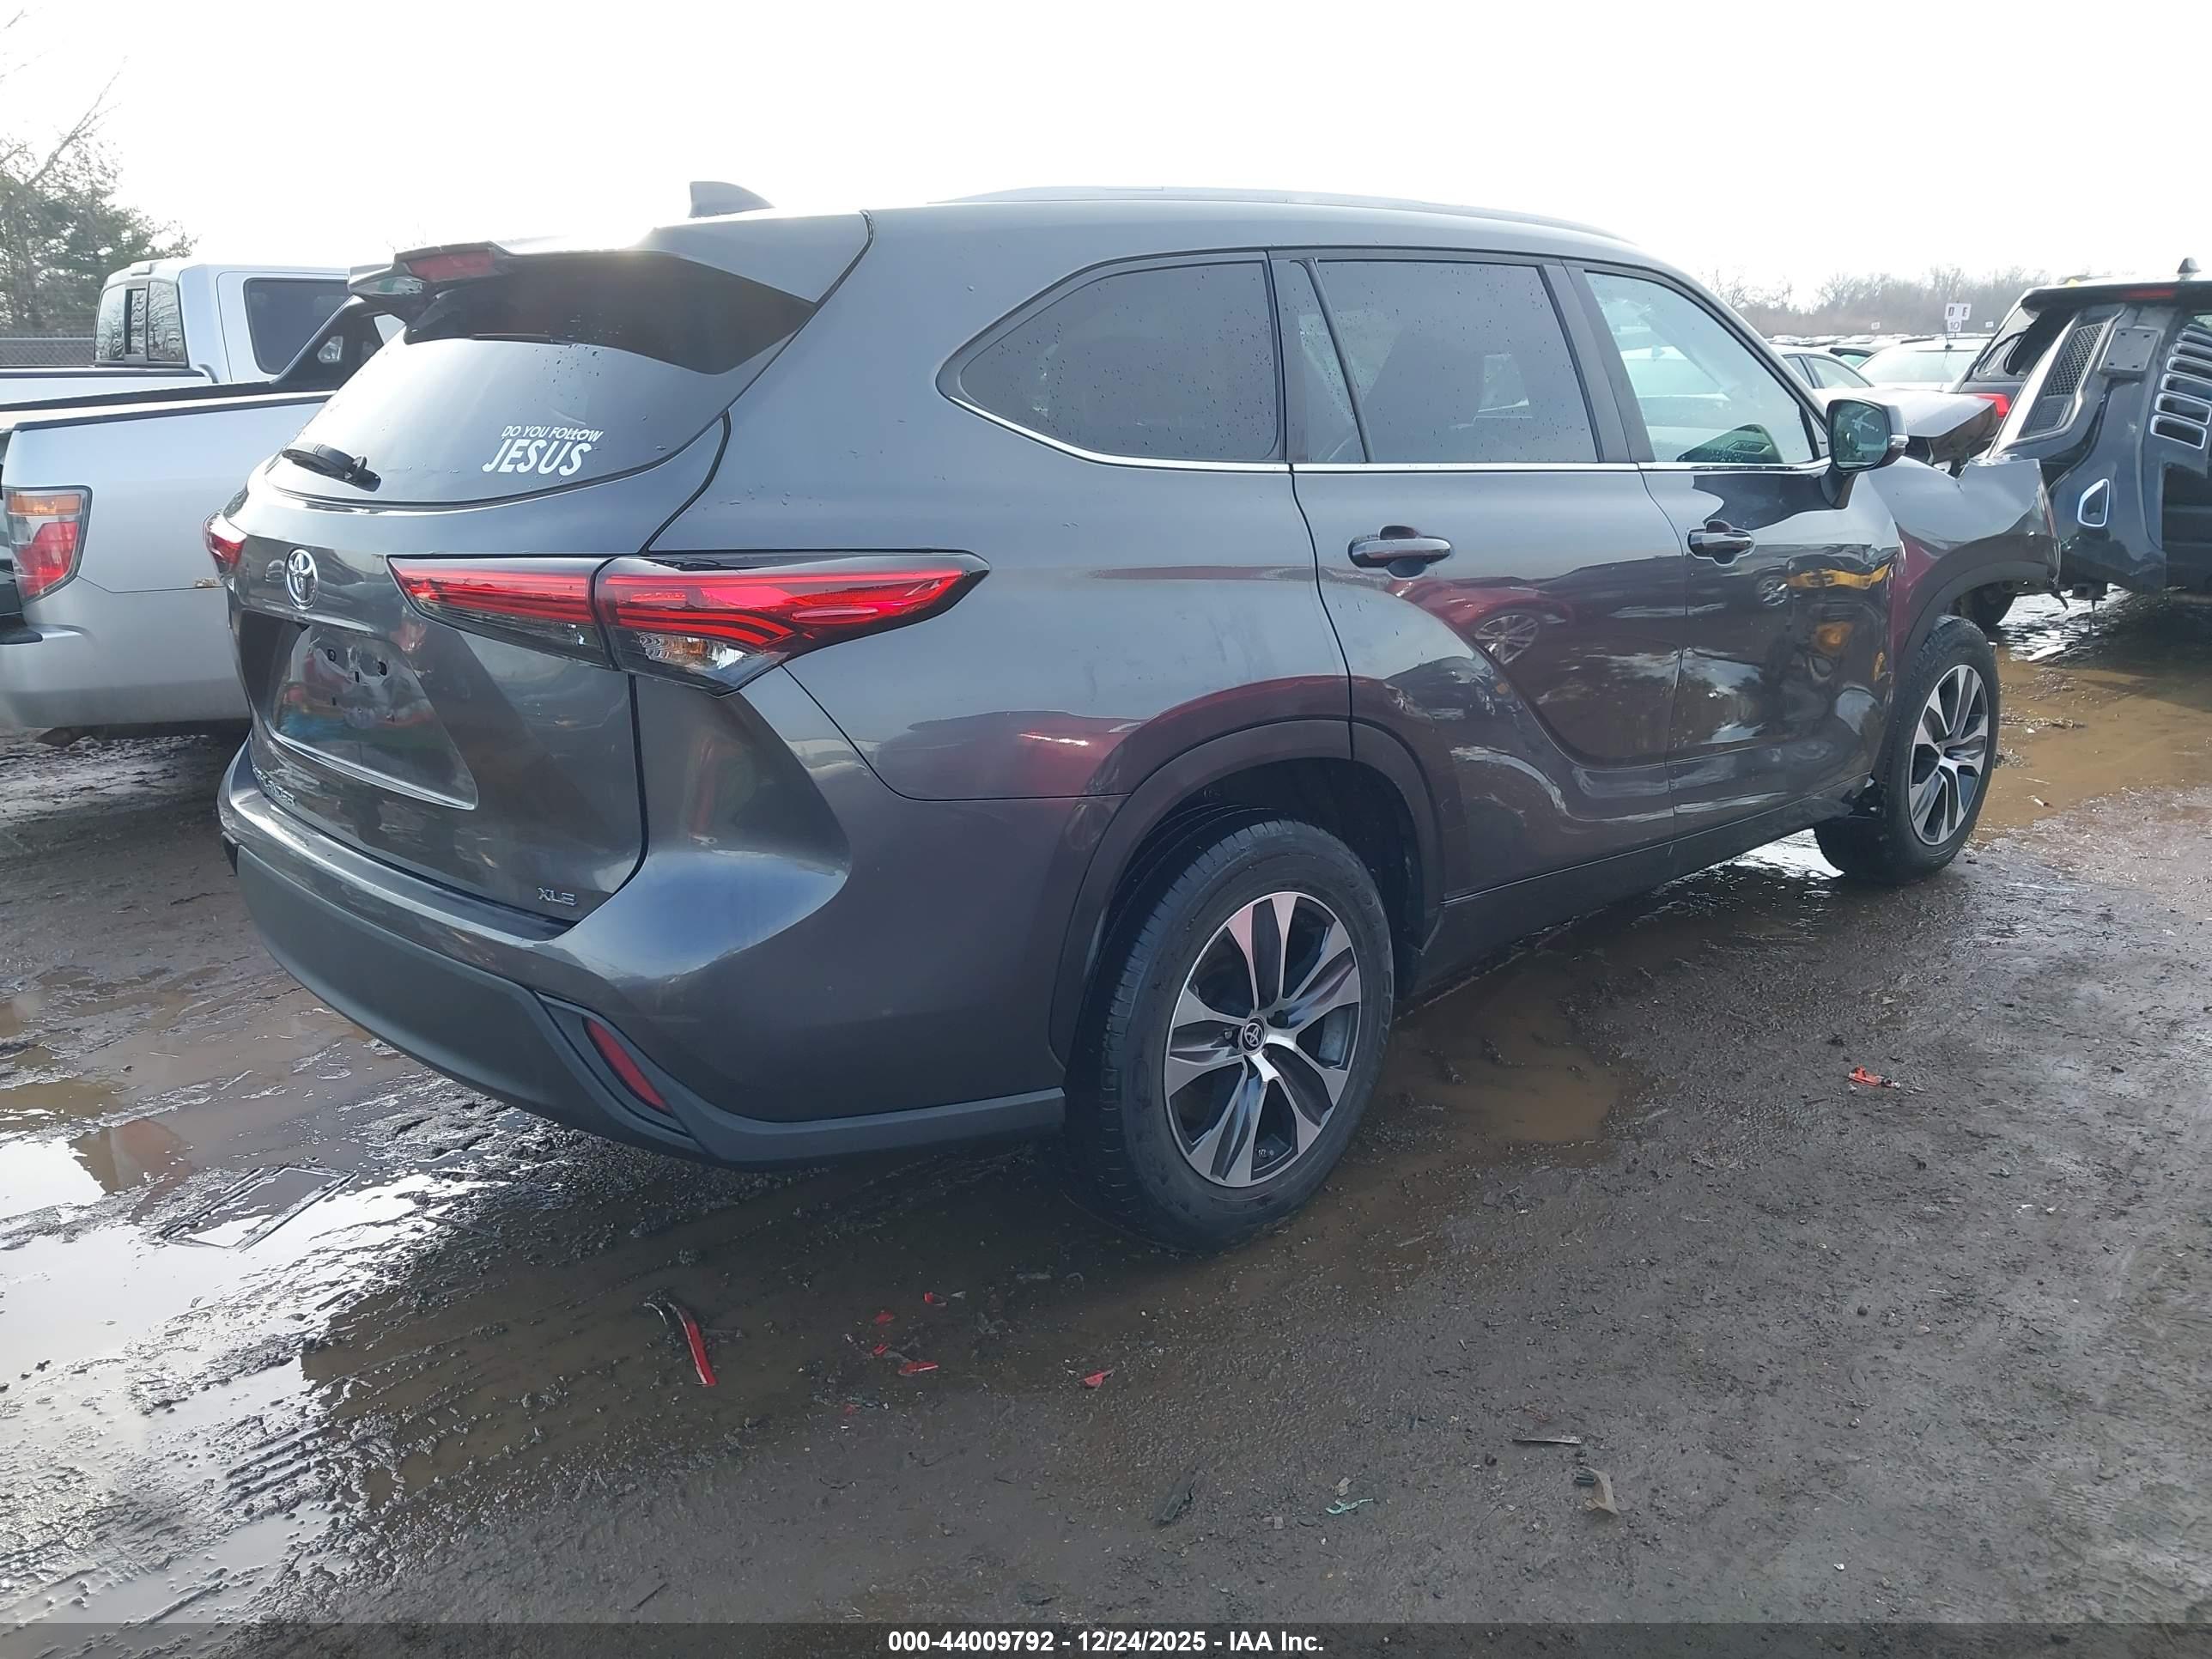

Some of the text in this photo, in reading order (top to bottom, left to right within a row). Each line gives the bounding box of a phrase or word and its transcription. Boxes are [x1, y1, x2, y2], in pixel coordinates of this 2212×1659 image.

[1949, 321, 1960, 331] 10
[501, 425, 604, 442] DO YOU FOLLOW
[482, 438, 592, 476] JESUS
[537, 887, 576, 907] XLE
